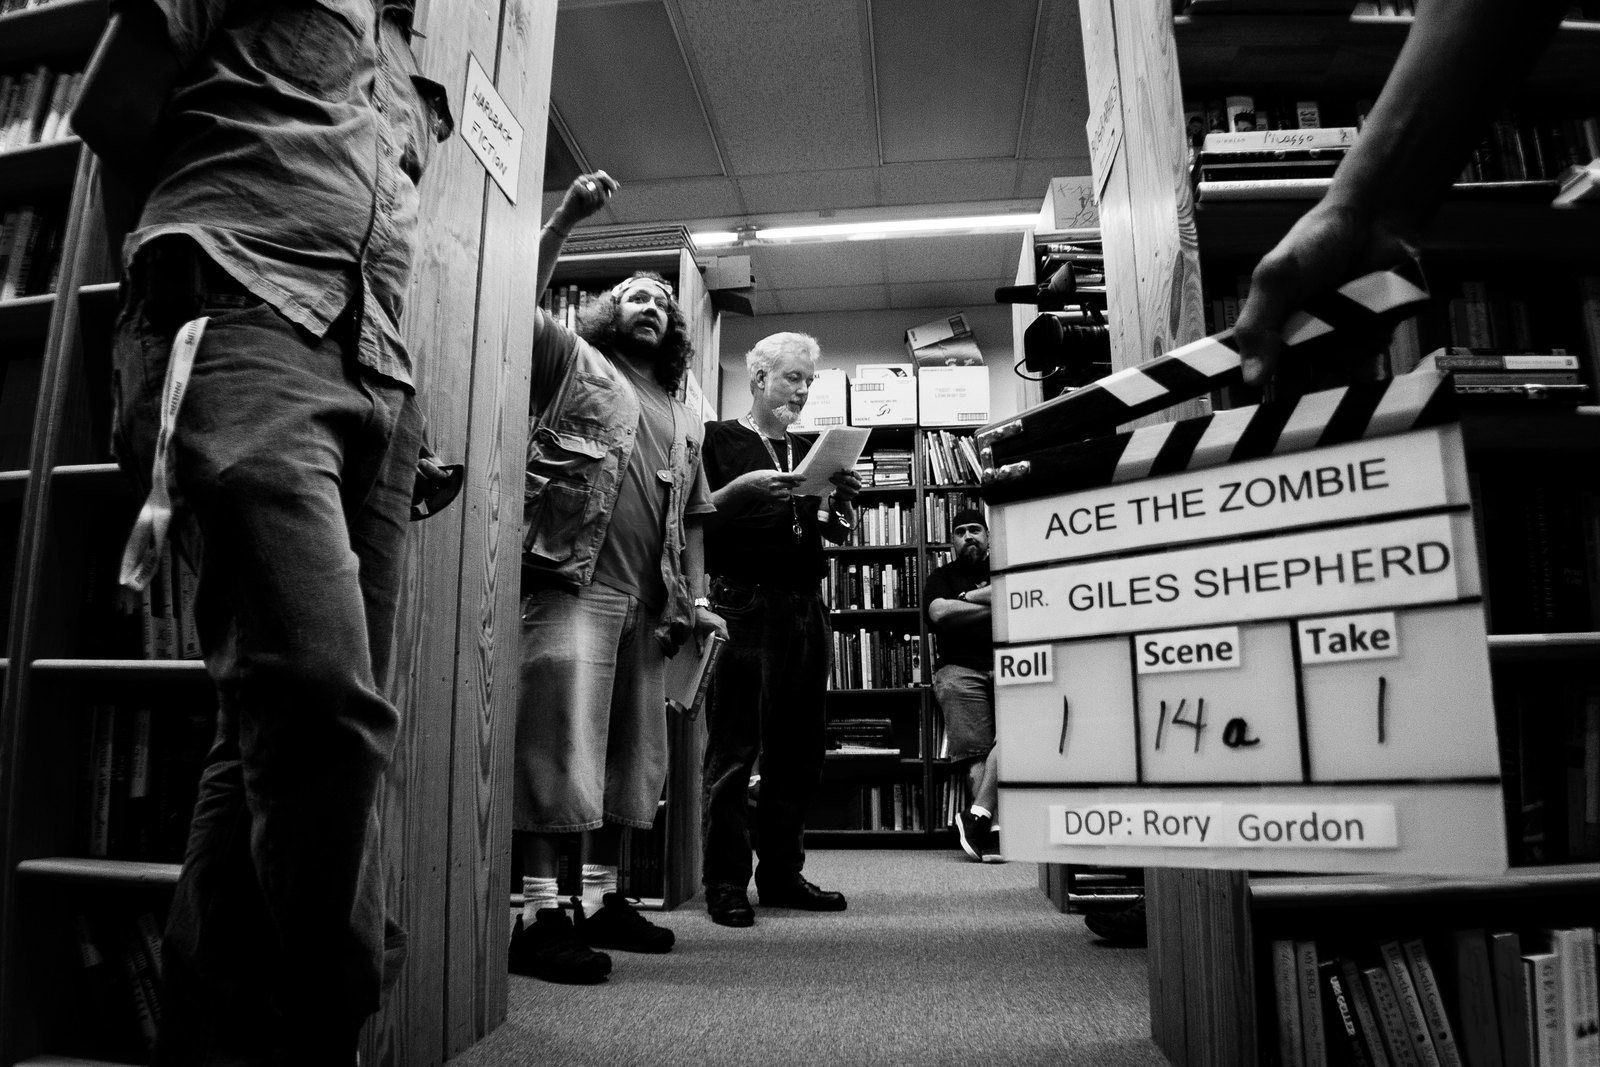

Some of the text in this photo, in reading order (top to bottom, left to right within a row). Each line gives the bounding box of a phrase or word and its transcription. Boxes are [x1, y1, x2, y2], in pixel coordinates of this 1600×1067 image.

[471, 121, 507, 175] FICTION
[1263, 131, 1314, 145] Picasso
[1044, 457, 1390, 540] ACE THE ZOMBIE
[1009, 540, 1452, 613] DIR. GILES SHEPHERD
[1143, 639, 1235, 667] Scene
[1304, 622, 1392, 656] Take
[1000, 650, 1049, 679] Roll
[1377, 675, 1388, 746] 1
[1064, 809, 1366, 844] DOP: Rory Gordon
[1386, 945, 1411, 995] Elizabeth
[1409, 943, 1434, 993] Elizabeth
